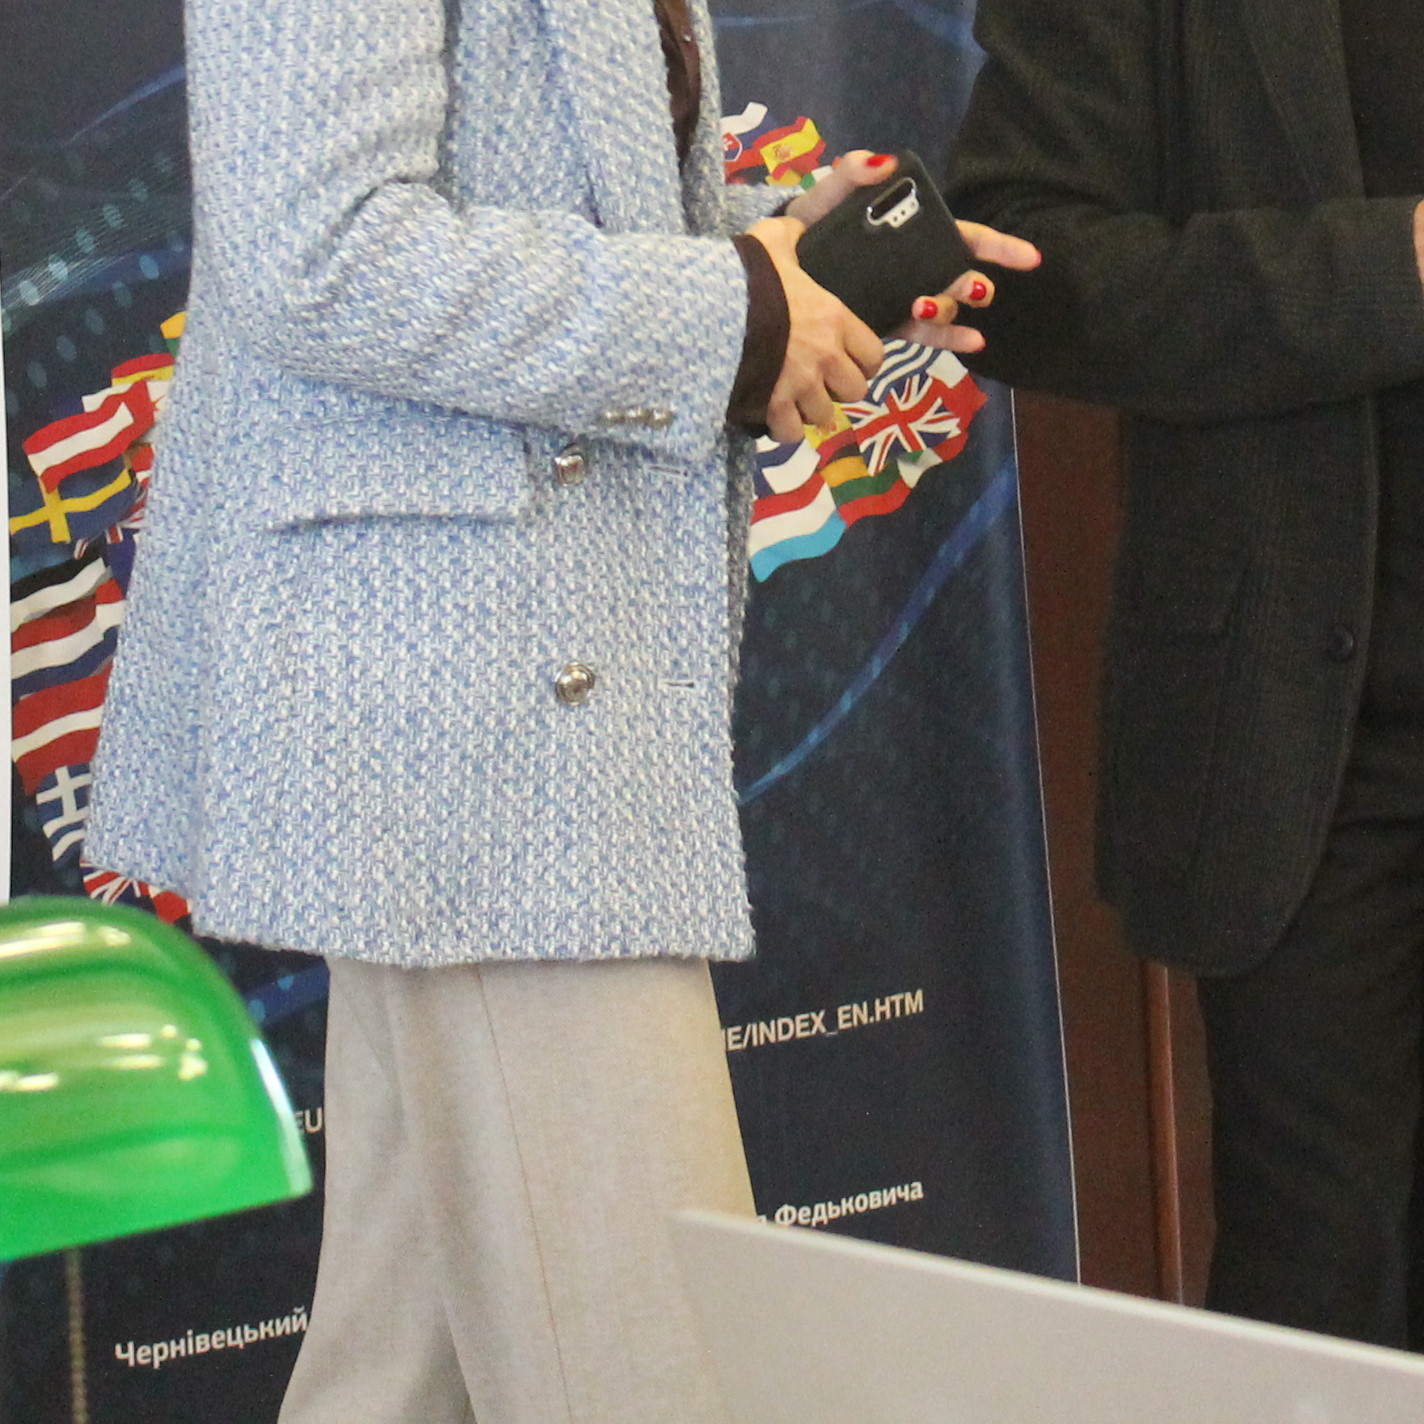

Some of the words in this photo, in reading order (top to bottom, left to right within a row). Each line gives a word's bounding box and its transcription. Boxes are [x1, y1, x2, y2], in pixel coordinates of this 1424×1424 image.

[722, 989, 924, 1052] E/INDEX_EN.HTM
[775, 1181, 924, 1228] Федьковича
[115, 1305, 308, 1369] Чернівецький
